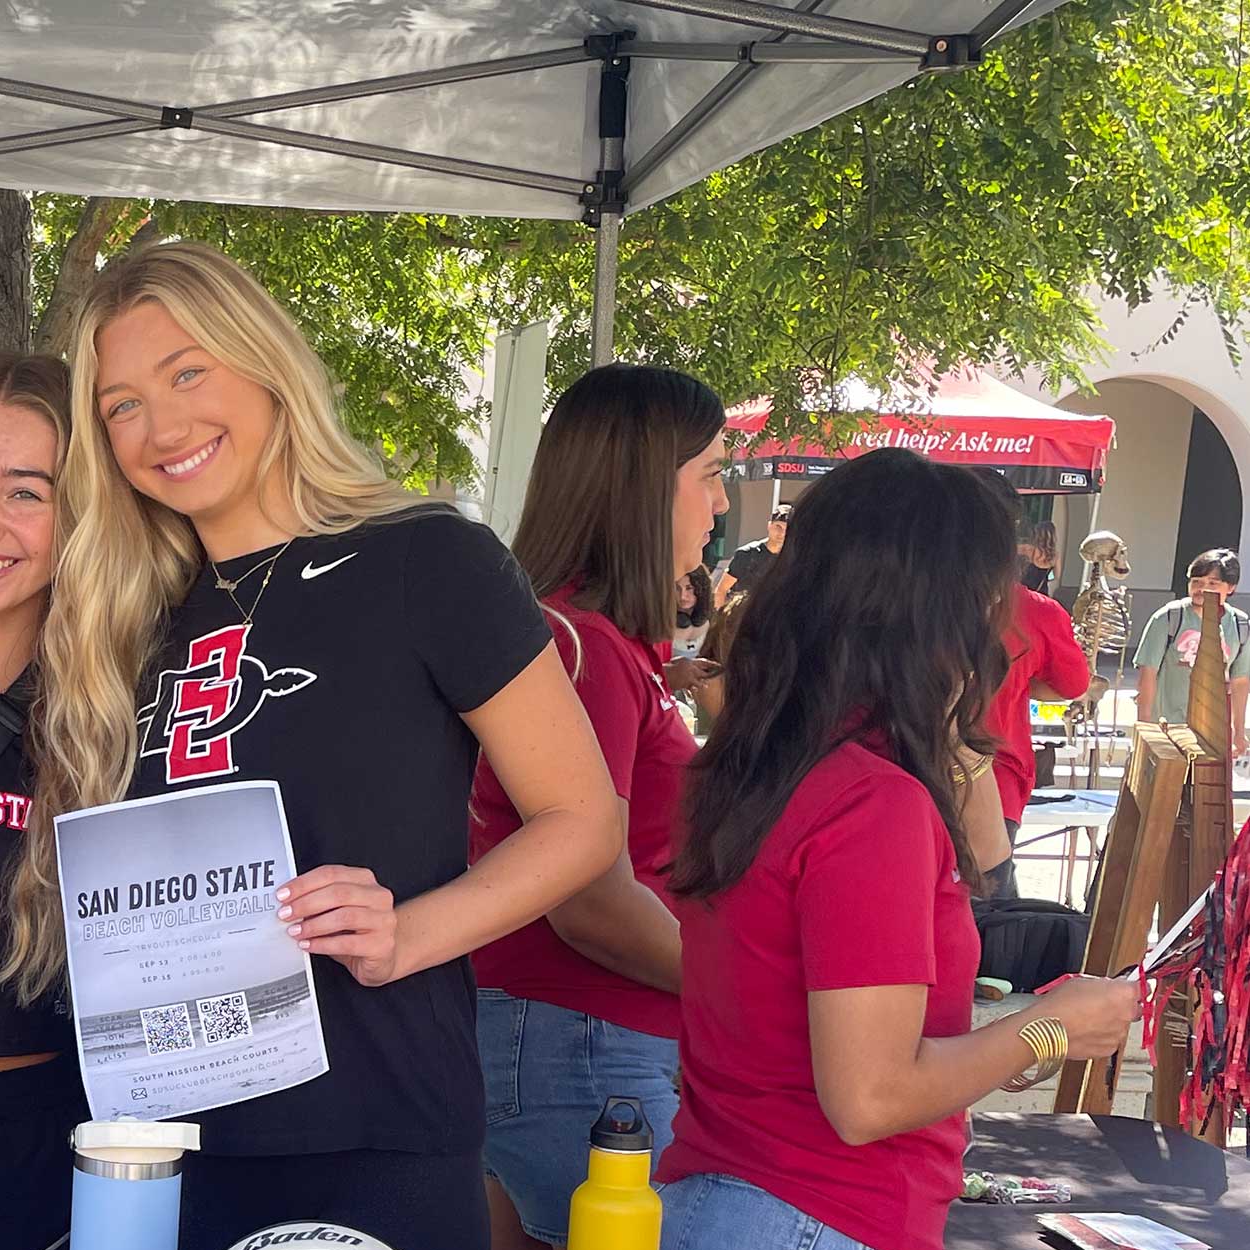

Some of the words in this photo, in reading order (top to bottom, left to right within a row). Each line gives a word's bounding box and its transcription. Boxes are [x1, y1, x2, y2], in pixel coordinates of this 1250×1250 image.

[893, 428, 951, 451] help?
[953, 431, 993, 453] Ask
[993, 434, 1034, 455] me!
[777, 462, 805, 473] SDSU
[77, 887, 119, 919] SAN
[129, 873, 197, 910] DIEGO
[206, 859, 275, 897] STATE
[83, 914, 145, 941] BEACH
[150, 893, 275, 929] VOLLEYBALL
[132, 1073, 164, 1084] SOUTH
[167, 1064, 207, 1077] MISSION
[209, 1056, 240, 1069] BEACH
[242, 1046, 280, 1061] COURTS
